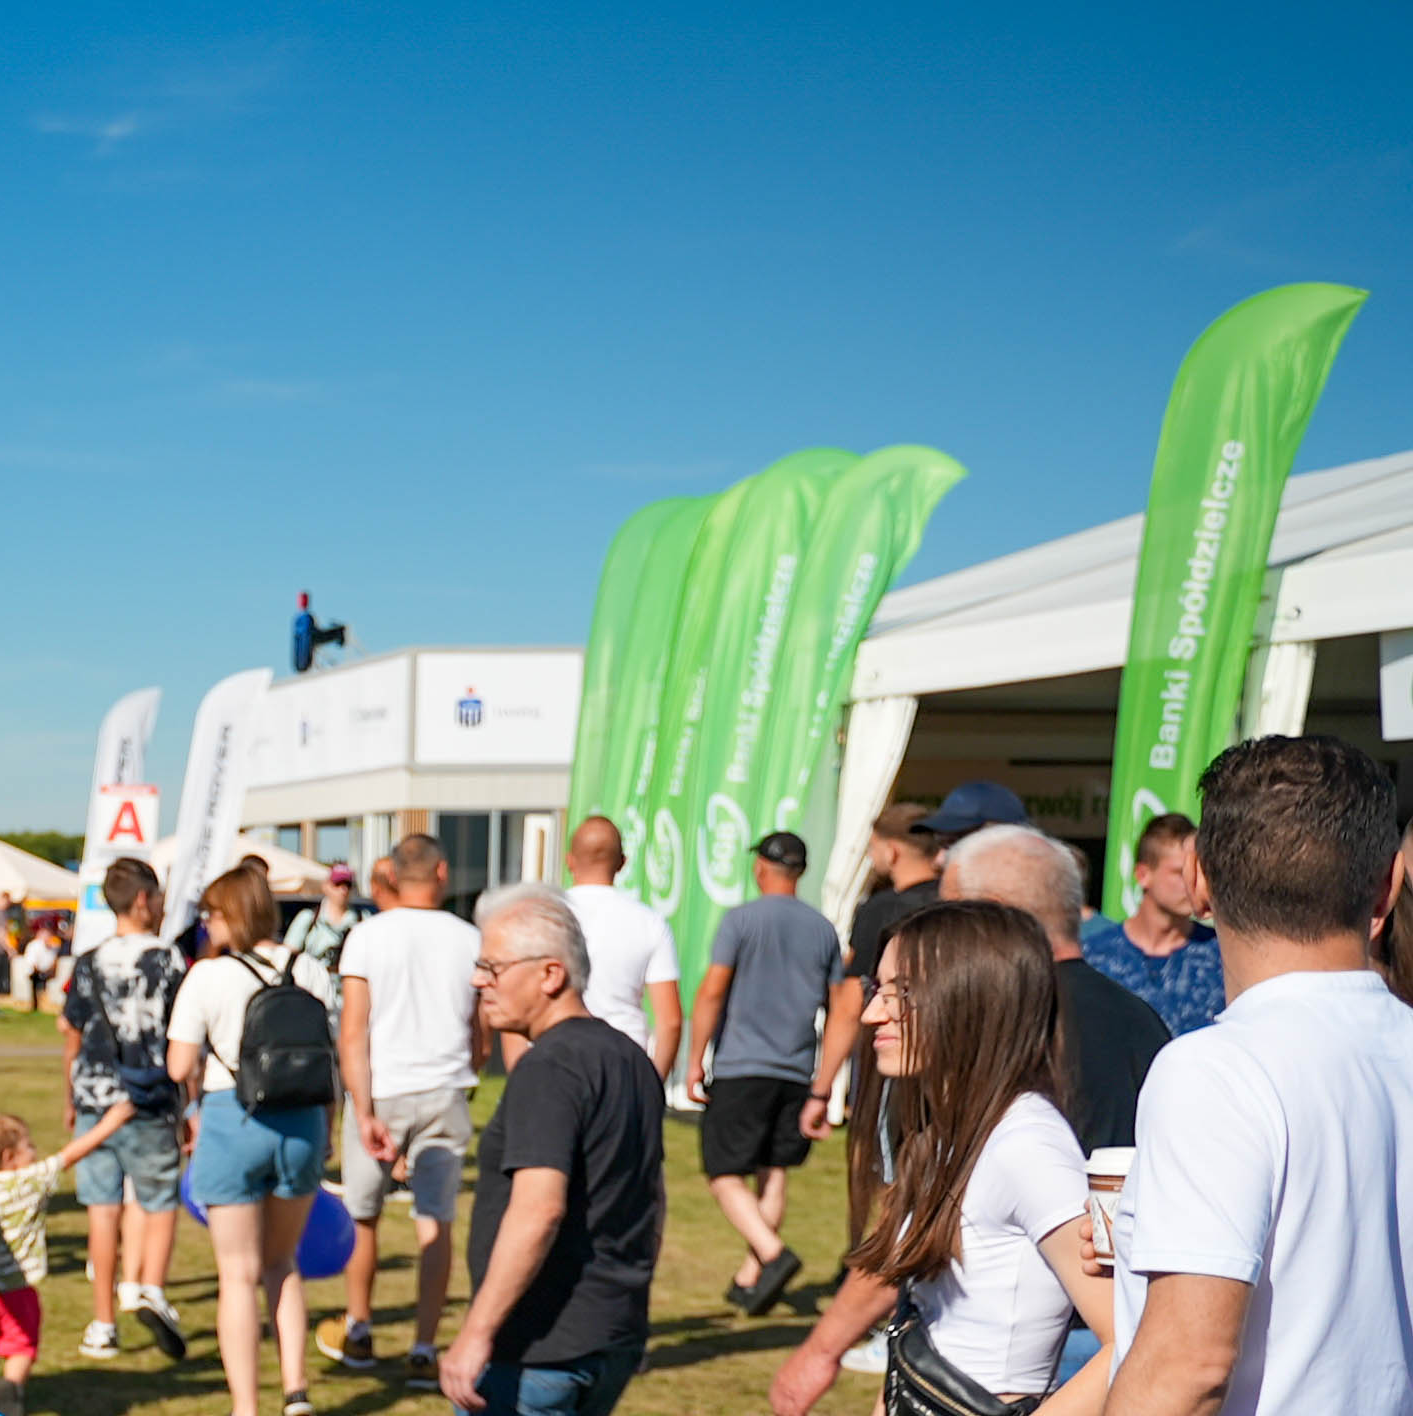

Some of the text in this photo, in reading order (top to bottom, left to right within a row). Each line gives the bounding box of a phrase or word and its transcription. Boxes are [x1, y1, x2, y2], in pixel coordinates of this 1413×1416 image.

[1149, 438, 1246, 771] Banki Spółdzielcze
[726, 710, 761, 784] Banki
[108, 800, 145, 843] A
